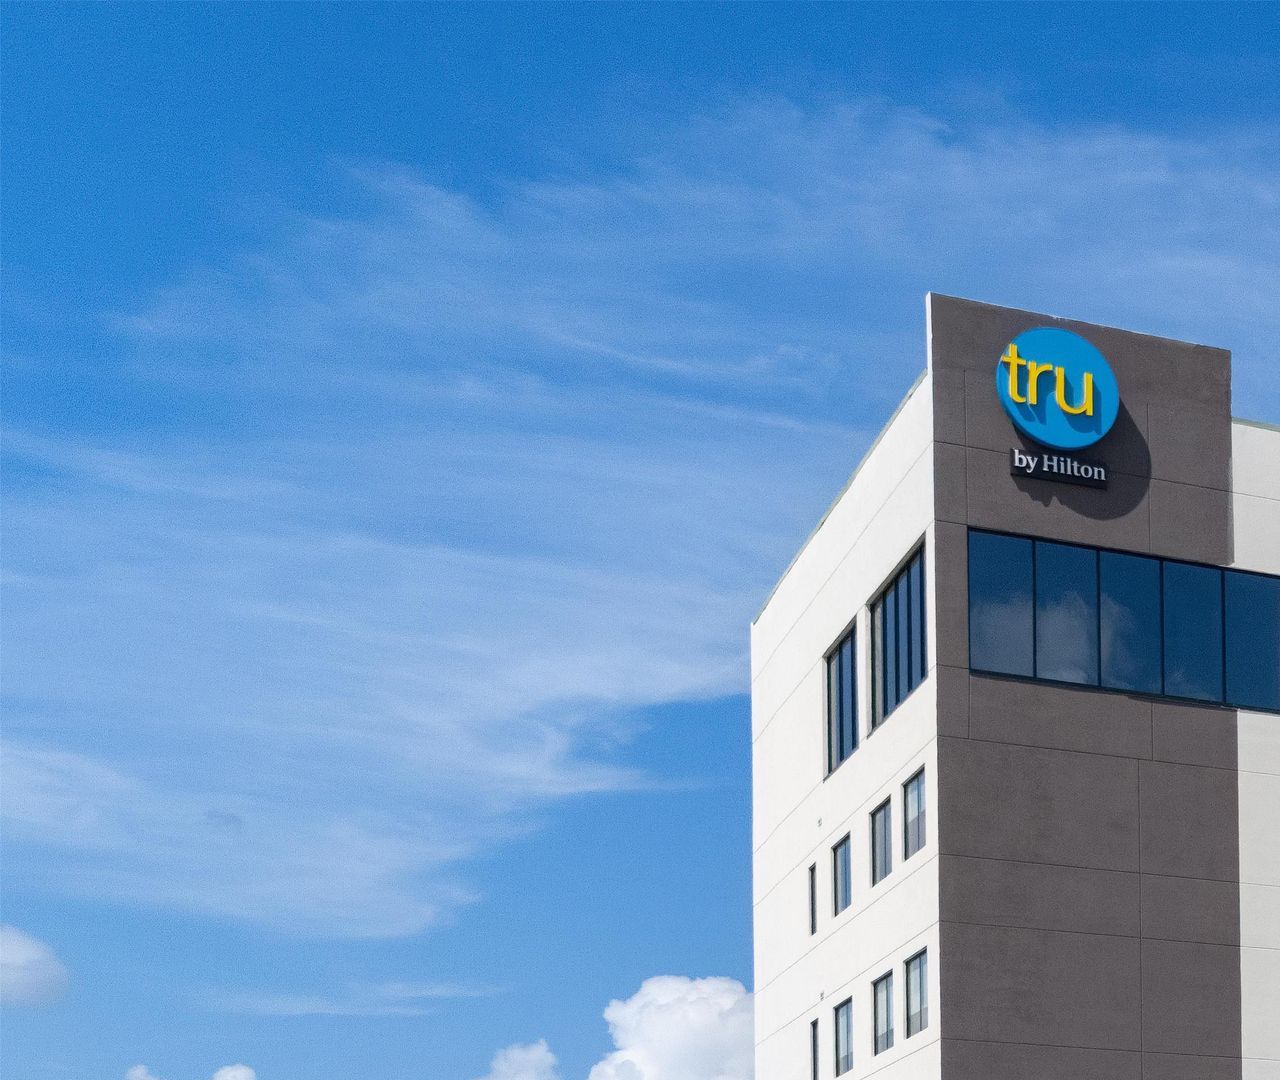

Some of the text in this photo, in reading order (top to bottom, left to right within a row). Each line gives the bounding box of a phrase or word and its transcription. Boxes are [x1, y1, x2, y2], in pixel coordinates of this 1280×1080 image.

[1001, 343, 1093, 416] tru
[1014, 449, 1106, 481] by Hilton
